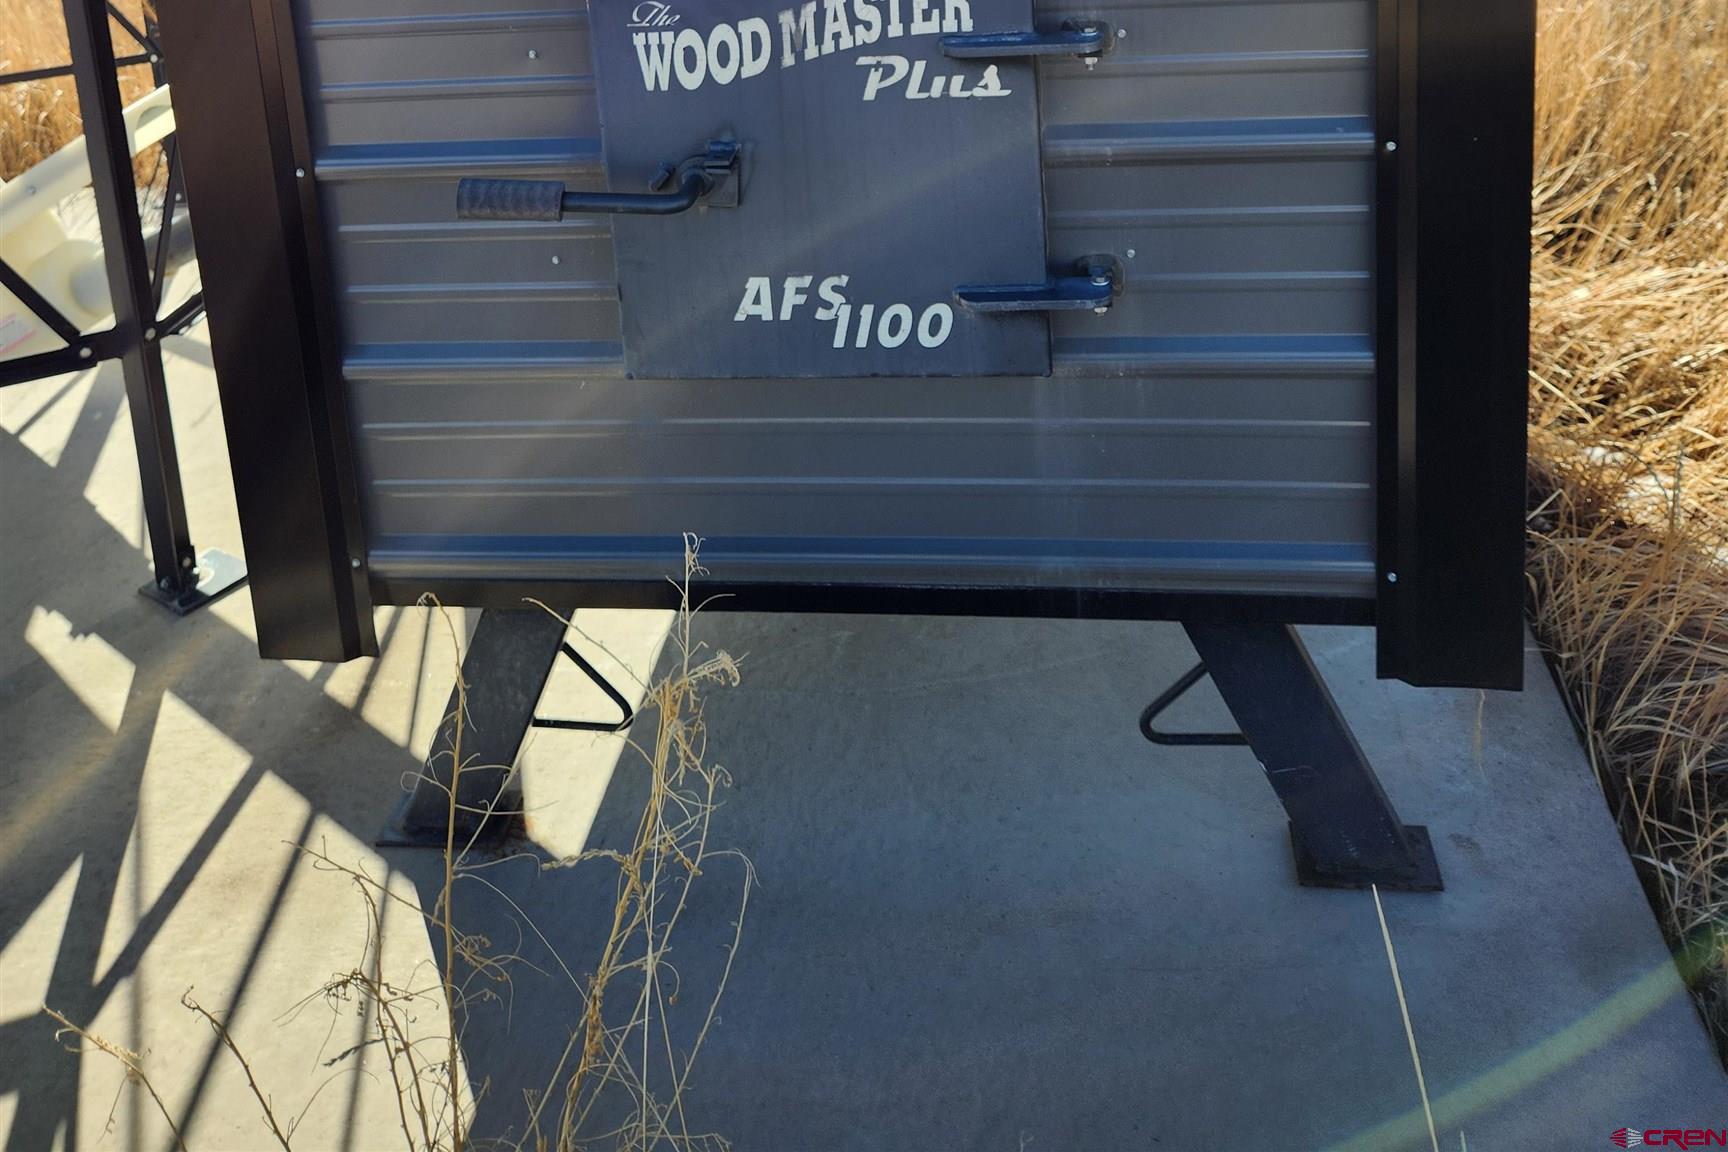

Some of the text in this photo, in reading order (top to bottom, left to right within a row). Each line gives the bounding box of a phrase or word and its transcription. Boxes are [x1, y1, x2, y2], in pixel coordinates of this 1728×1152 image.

[626, 0, 681, 27] The
[856, 55, 1012, 101] Plus
[733, 274, 850, 322] AFS
[832, 302, 954, 349] 1100
